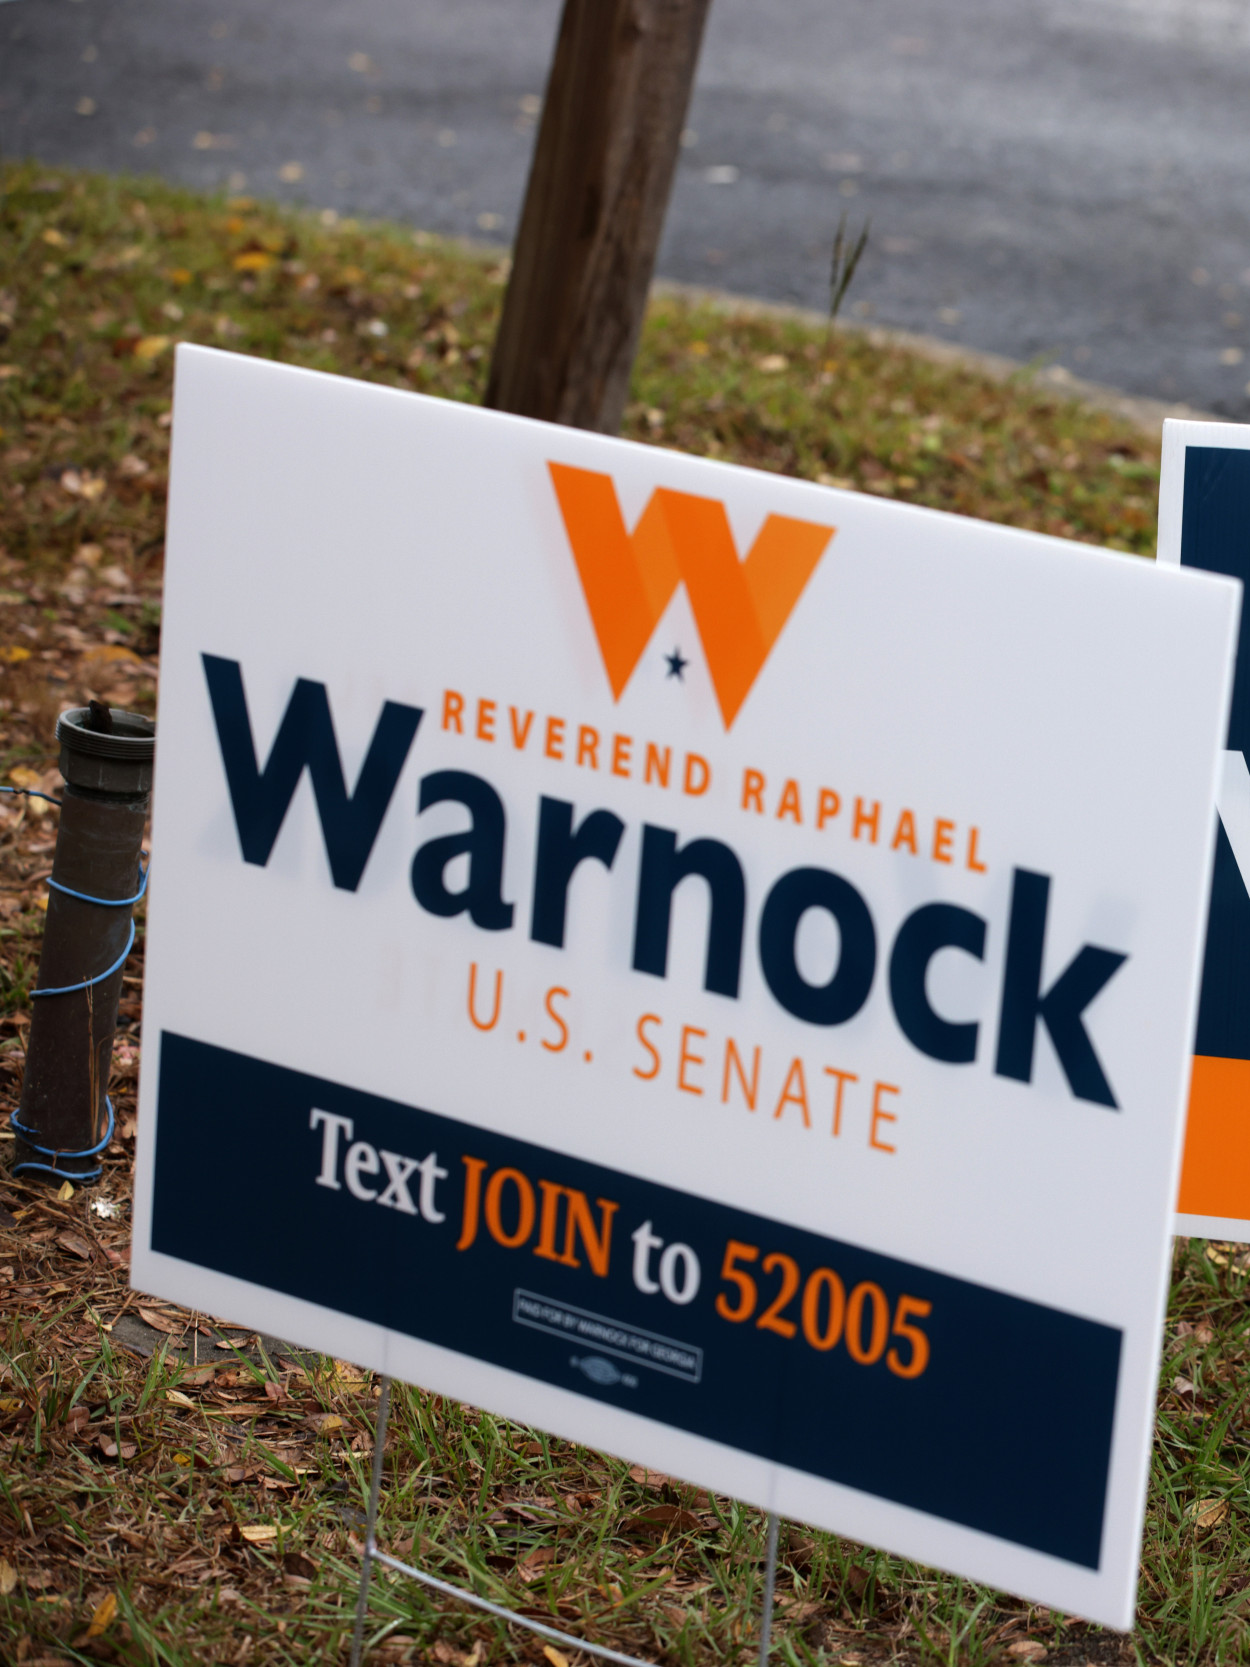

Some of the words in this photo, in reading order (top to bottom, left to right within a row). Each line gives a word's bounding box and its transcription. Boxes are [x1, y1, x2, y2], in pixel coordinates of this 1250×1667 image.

[200, 651, 1131, 1113] Warnock
[440, 689, 712, 797] REVEREND
[741, 768, 987, 873] RAPHAEL
[465, 962, 594, 1062] U.S.
[632, 1014, 902, 1153] SENATE
[309, 1107, 448, 1223] Text
[456, 1155, 619, 1278] JOIN
[631, 1220, 701, 1305] to
[715, 1239, 933, 1379] 52005
